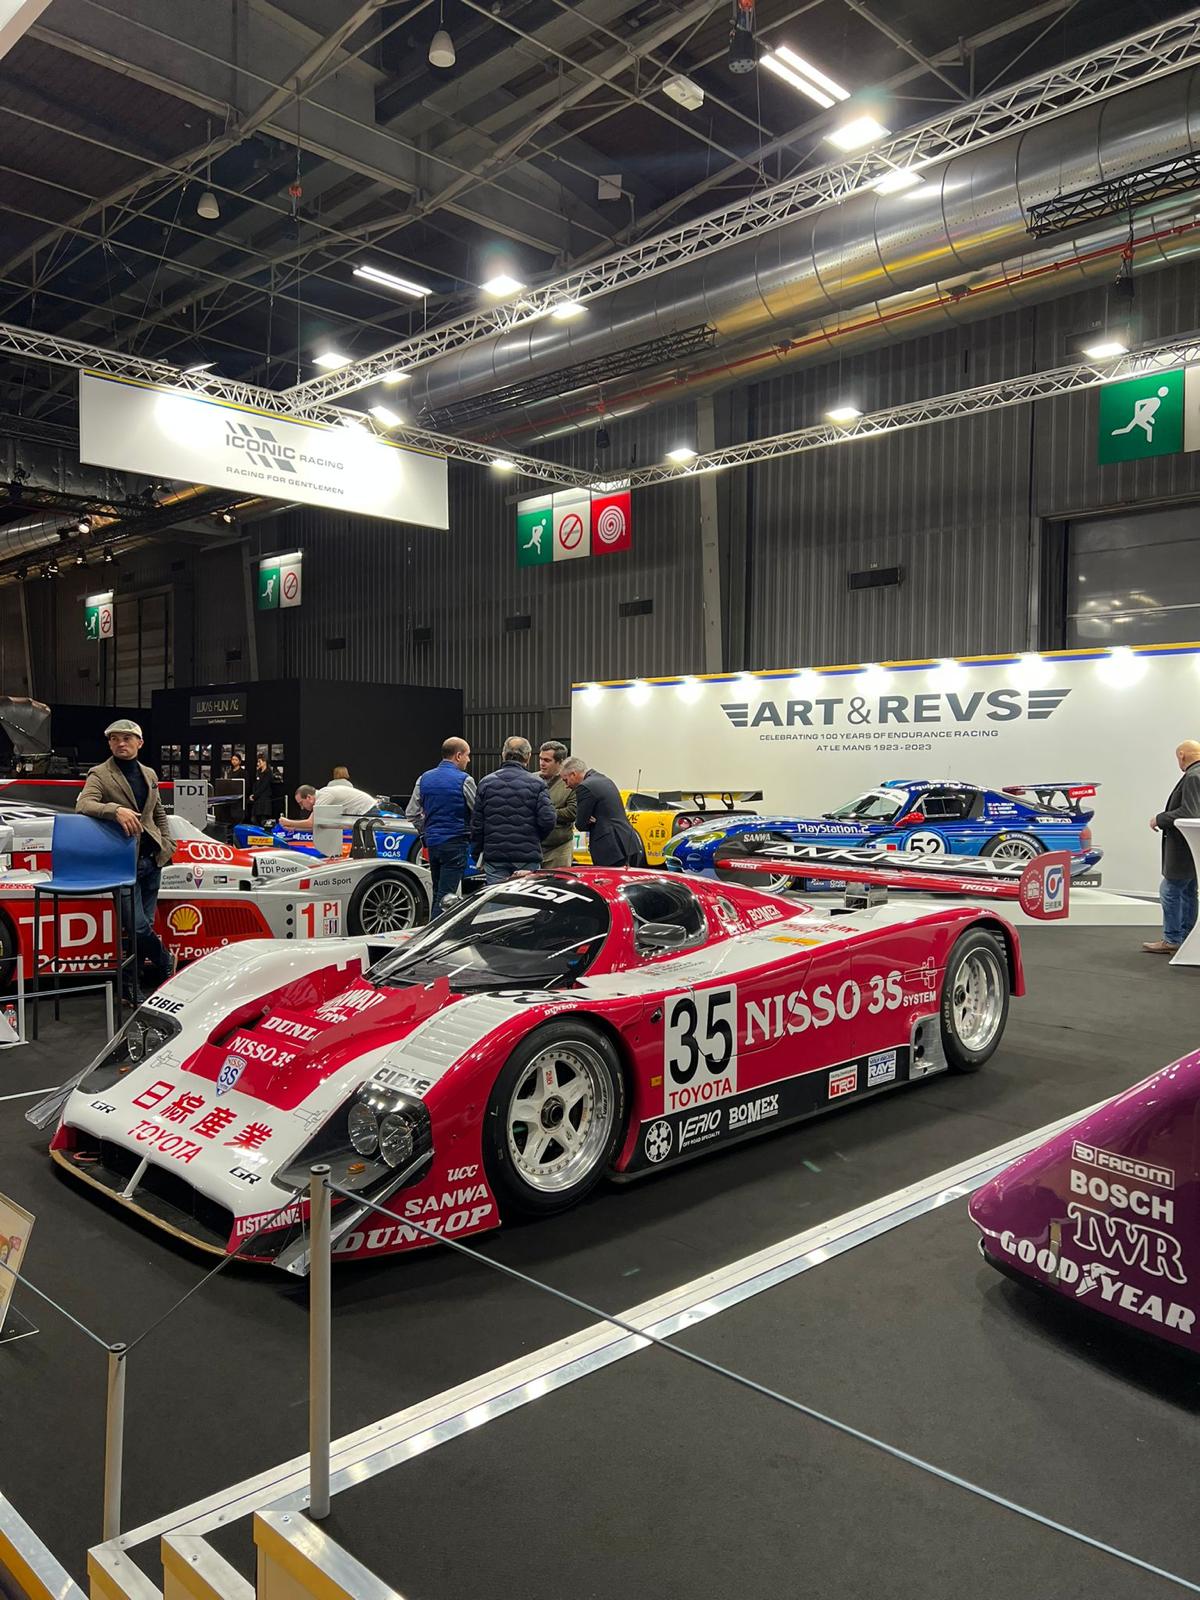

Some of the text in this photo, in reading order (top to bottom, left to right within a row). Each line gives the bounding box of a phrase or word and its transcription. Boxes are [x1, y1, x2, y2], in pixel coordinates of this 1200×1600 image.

[226, 434, 344, 470] ICONIC RACING
[226, 466, 344, 495] RACING FOR GENTLEMEN
[840, 732, 871, 740] YEARS
[888, 731, 952, 739] ENDURANCE
[954, 730, 999, 738] RACING
[176, 785, 205, 796] TDI
[743, 832, 772, 843] SANWA
[910, 838, 941, 855] 52
[24, 854, 37, 871] 1
[261, 865, 298, 874] TDI Power
[313, 877, 352, 888] Audi Sport
[19, 910, 113, 950] TDI
[301, 903, 315, 939] 1
[323, 902, 338, 917] P1
[745, 970, 936, 1046] NISSO 3S SYSTEM
[261, 1017, 324, 1041] DUNL
[669, 989, 733, 1085] 35
[227, 1036, 277, 1063] NISSO
[220, 1066, 239, 1085] 3S
[90, 1100, 116, 1114] GR
[669, 1077, 732, 1110] TOYOTA
[728, 1094, 779, 1124] BOMEX
[128, 1120, 203, 1164] TOYOTA
[229, 1166, 262, 1185] GR
[404, 1184, 488, 1217] SANWA
[1070, 1169, 1174, 1225] BOSCH
[341, 1204, 492, 1252] DUNLOP
[1067, 1201, 1188, 1285] TWR
